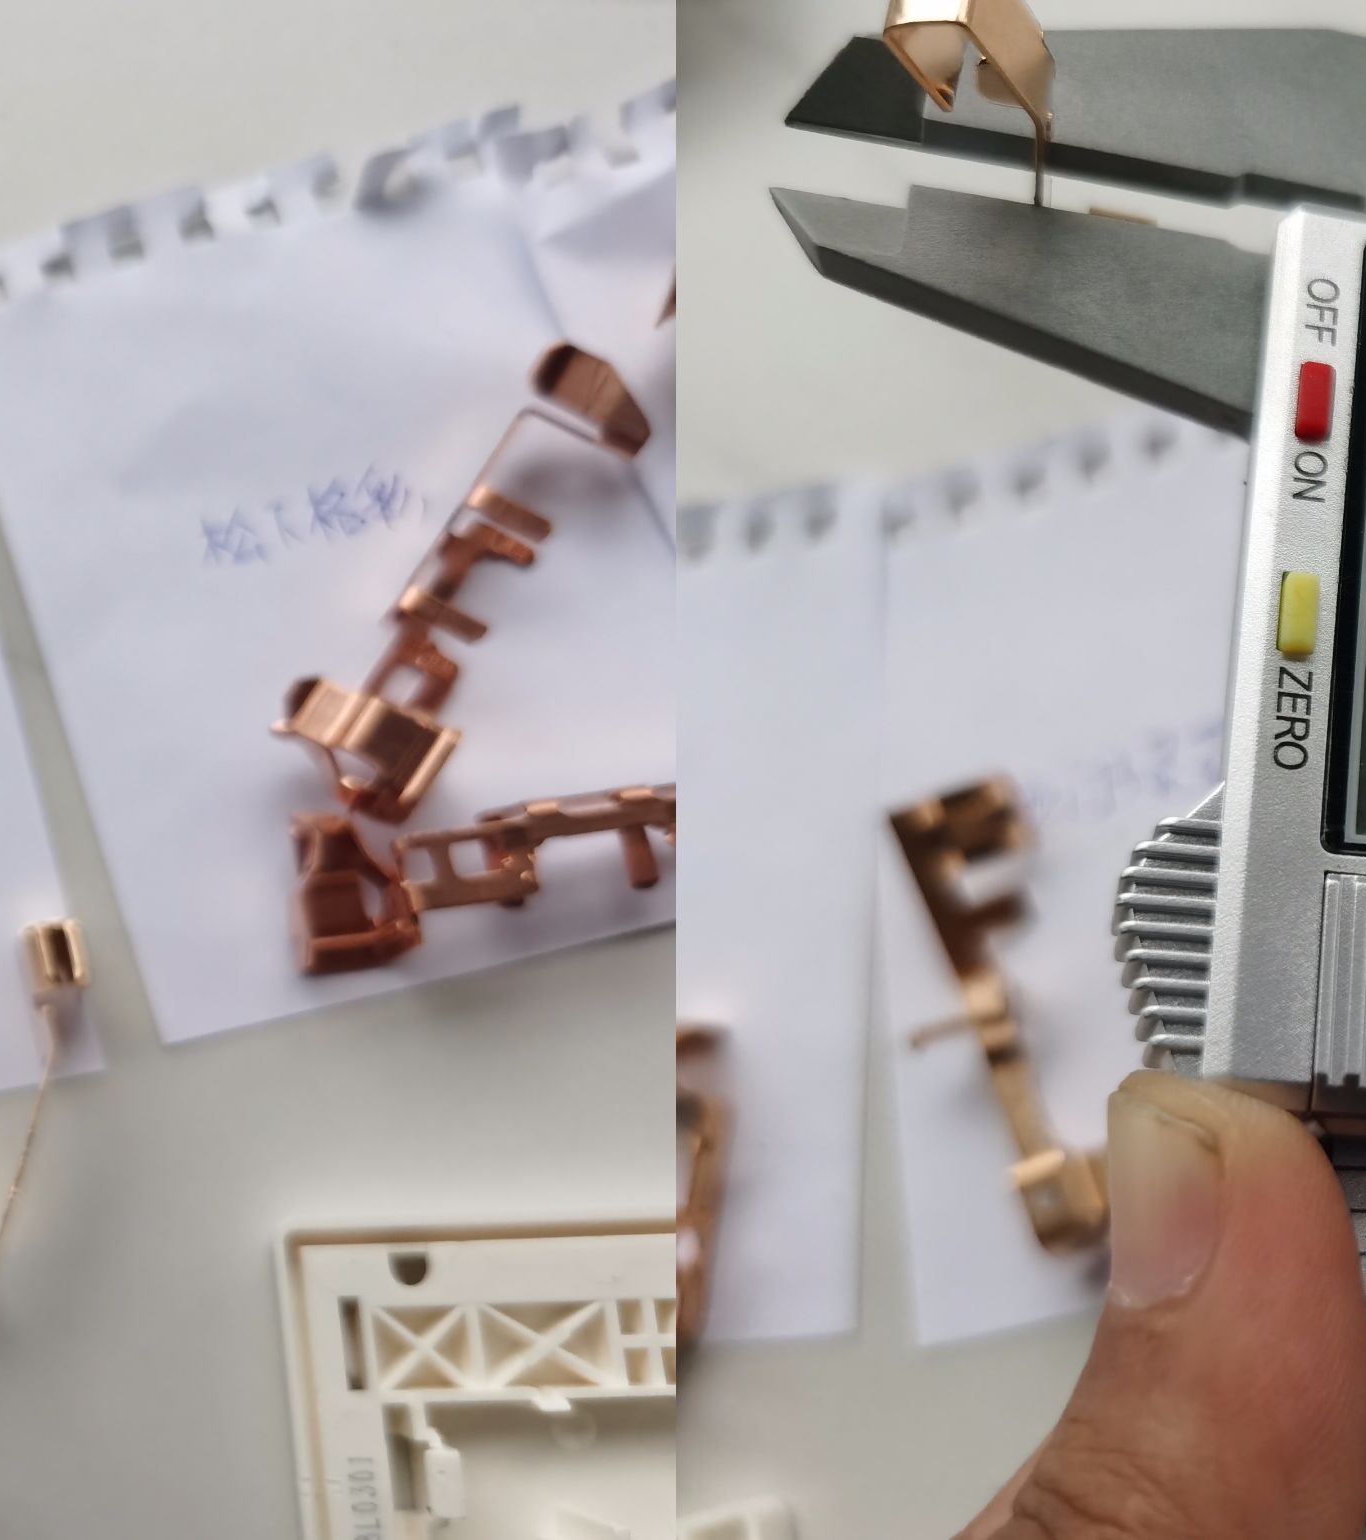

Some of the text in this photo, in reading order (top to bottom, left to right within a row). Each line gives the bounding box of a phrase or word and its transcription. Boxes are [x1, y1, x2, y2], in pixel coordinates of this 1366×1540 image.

[1305, 277, 1340, 347] OFF
[1292, 450, 1329, 504] ON
[1272, 665, 1314, 772] ZERO
